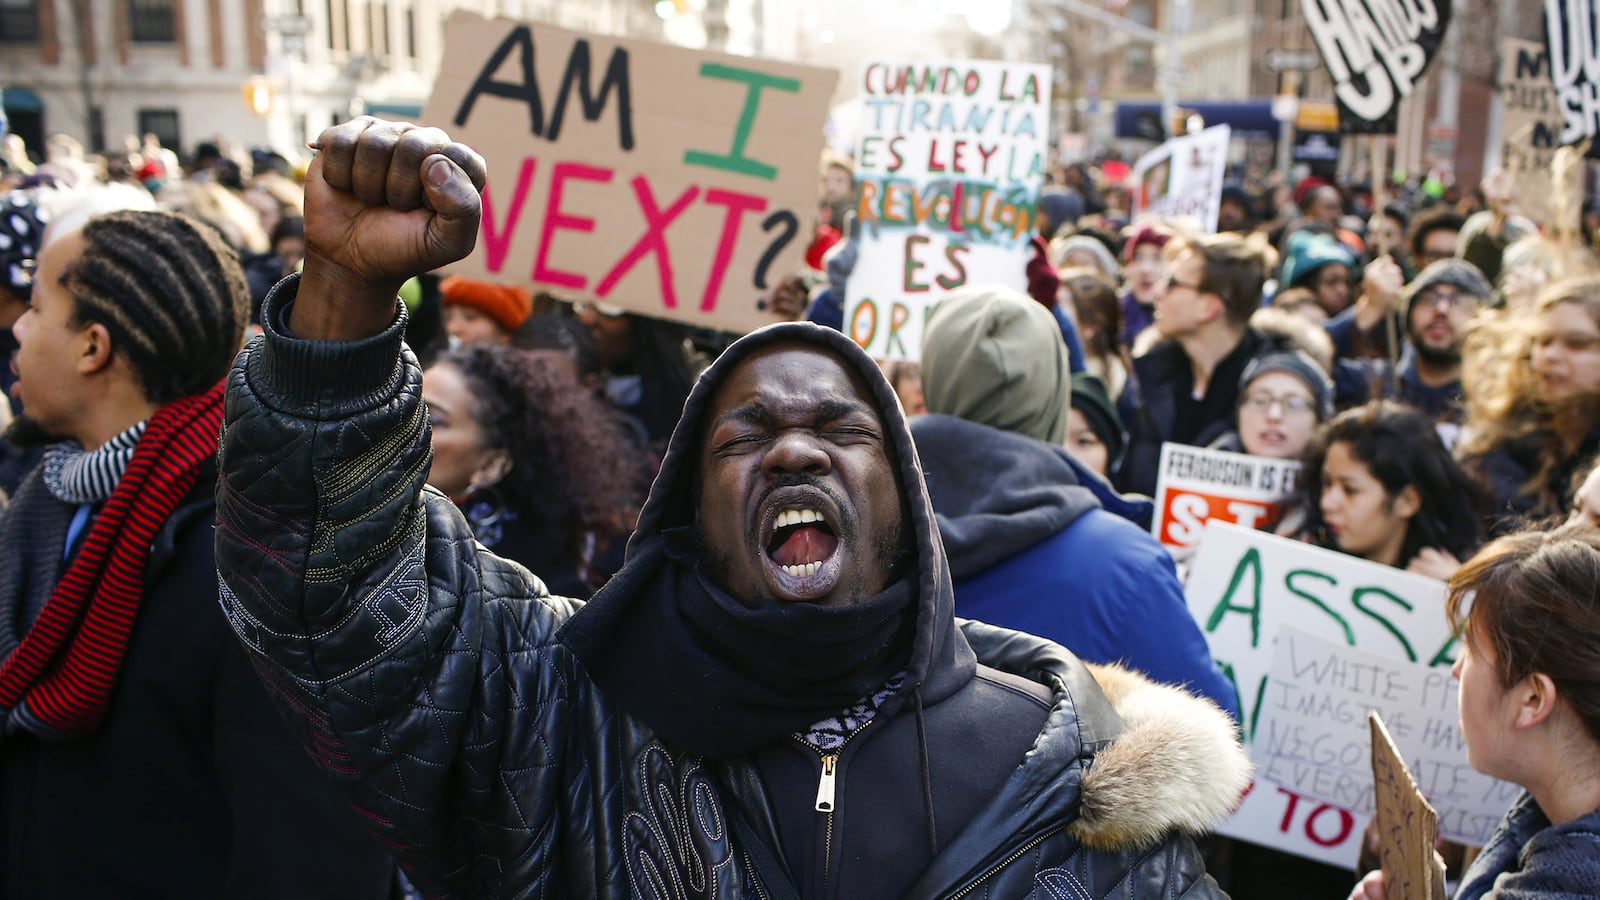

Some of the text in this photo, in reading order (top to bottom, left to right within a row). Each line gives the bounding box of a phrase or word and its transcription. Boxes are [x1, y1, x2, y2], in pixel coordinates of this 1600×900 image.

[453, 24, 801, 181] AM I
[865, 63, 1041, 104] CUANDO LA
[1336, 40, 1426, 121] UP
[861, 136, 906, 173] ES
[479, 145, 799, 312] NEXT?
[904, 236, 969, 292] ES
[852, 299, 929, 358] OR
[1167, 451, 1253, 487] FERGUSON
[1259, 465, 1275, 491] IS
[1289, 635, 1410, 702] WHITE
[1277, 787, 1355, 848] TO
